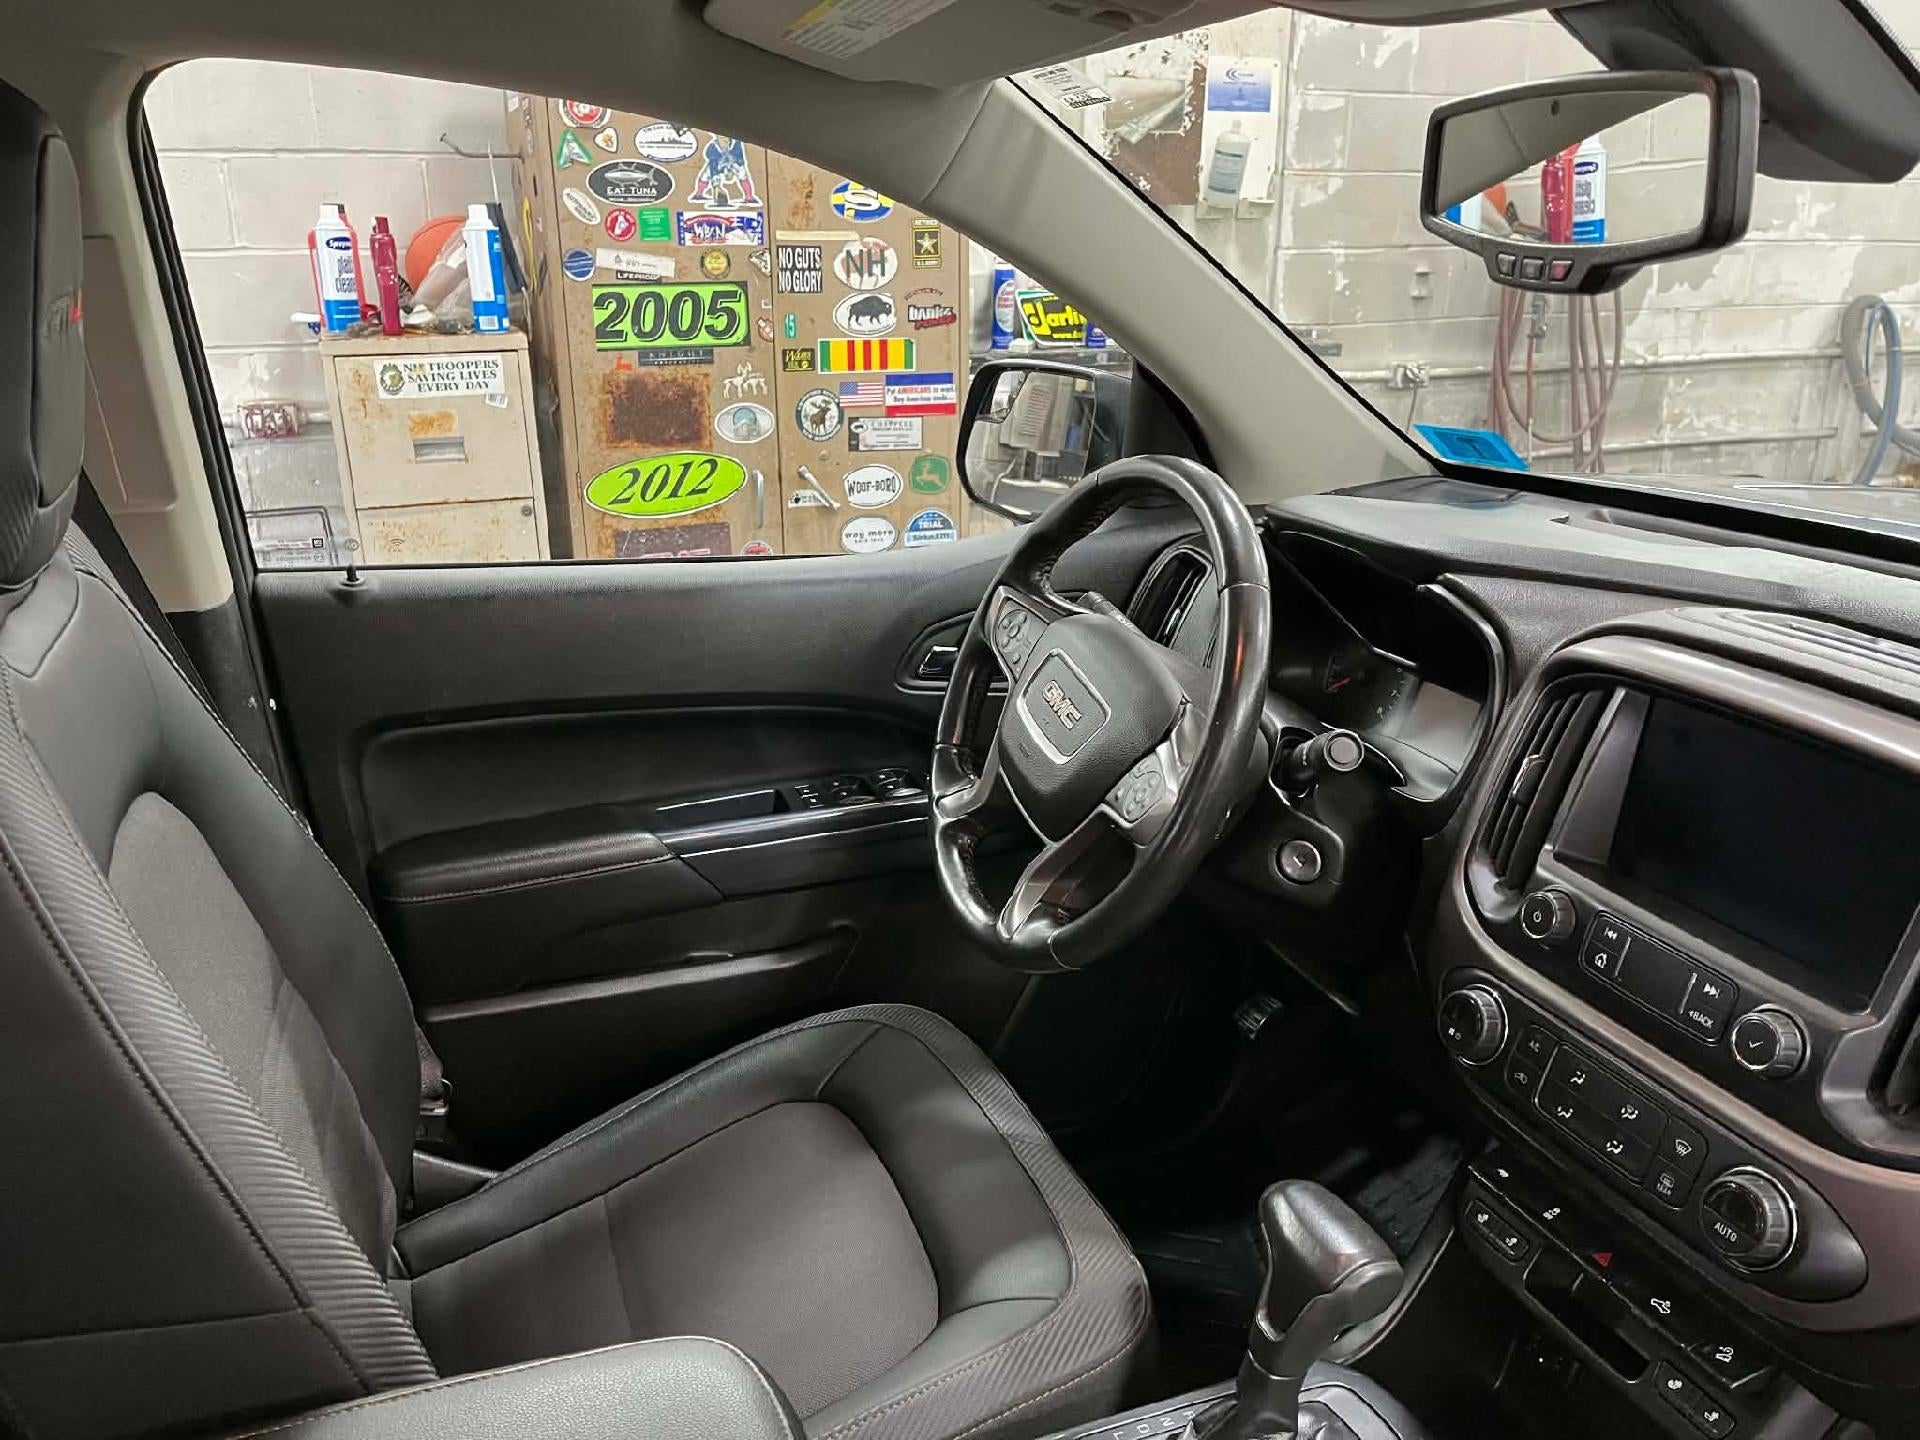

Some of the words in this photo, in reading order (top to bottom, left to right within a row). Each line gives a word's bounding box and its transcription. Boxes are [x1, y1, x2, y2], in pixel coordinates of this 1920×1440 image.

[606, 187, 626, 195] EAT
[629, 187, 657, 195] TUNA
[778, 247, 793, 269] NO
[794, 247, 821, 269] GUTS
[846, 249, 886, 278] NH
[778, 270, 792, 292] NO
[793, 270, 822, 292] GLORY
[593, 290, 742, 343] 2005
[428, 359, 499, 371] TROOPERS
[407, 371, 455, 383] SAVING
[459, 369, 497, 381] LIVES
[417, 382, 460, 393] EVERY
[465, 380, 490, 390] DAY
[607, 458, 718, 506] 2012
[919, 520, 945, 529] TRIAL
[1043, 680, 1082, 730] GMC
[1692, 1011, 1714, 1029] BACK
[1713, 1222, 1738, 1242] AUTO
